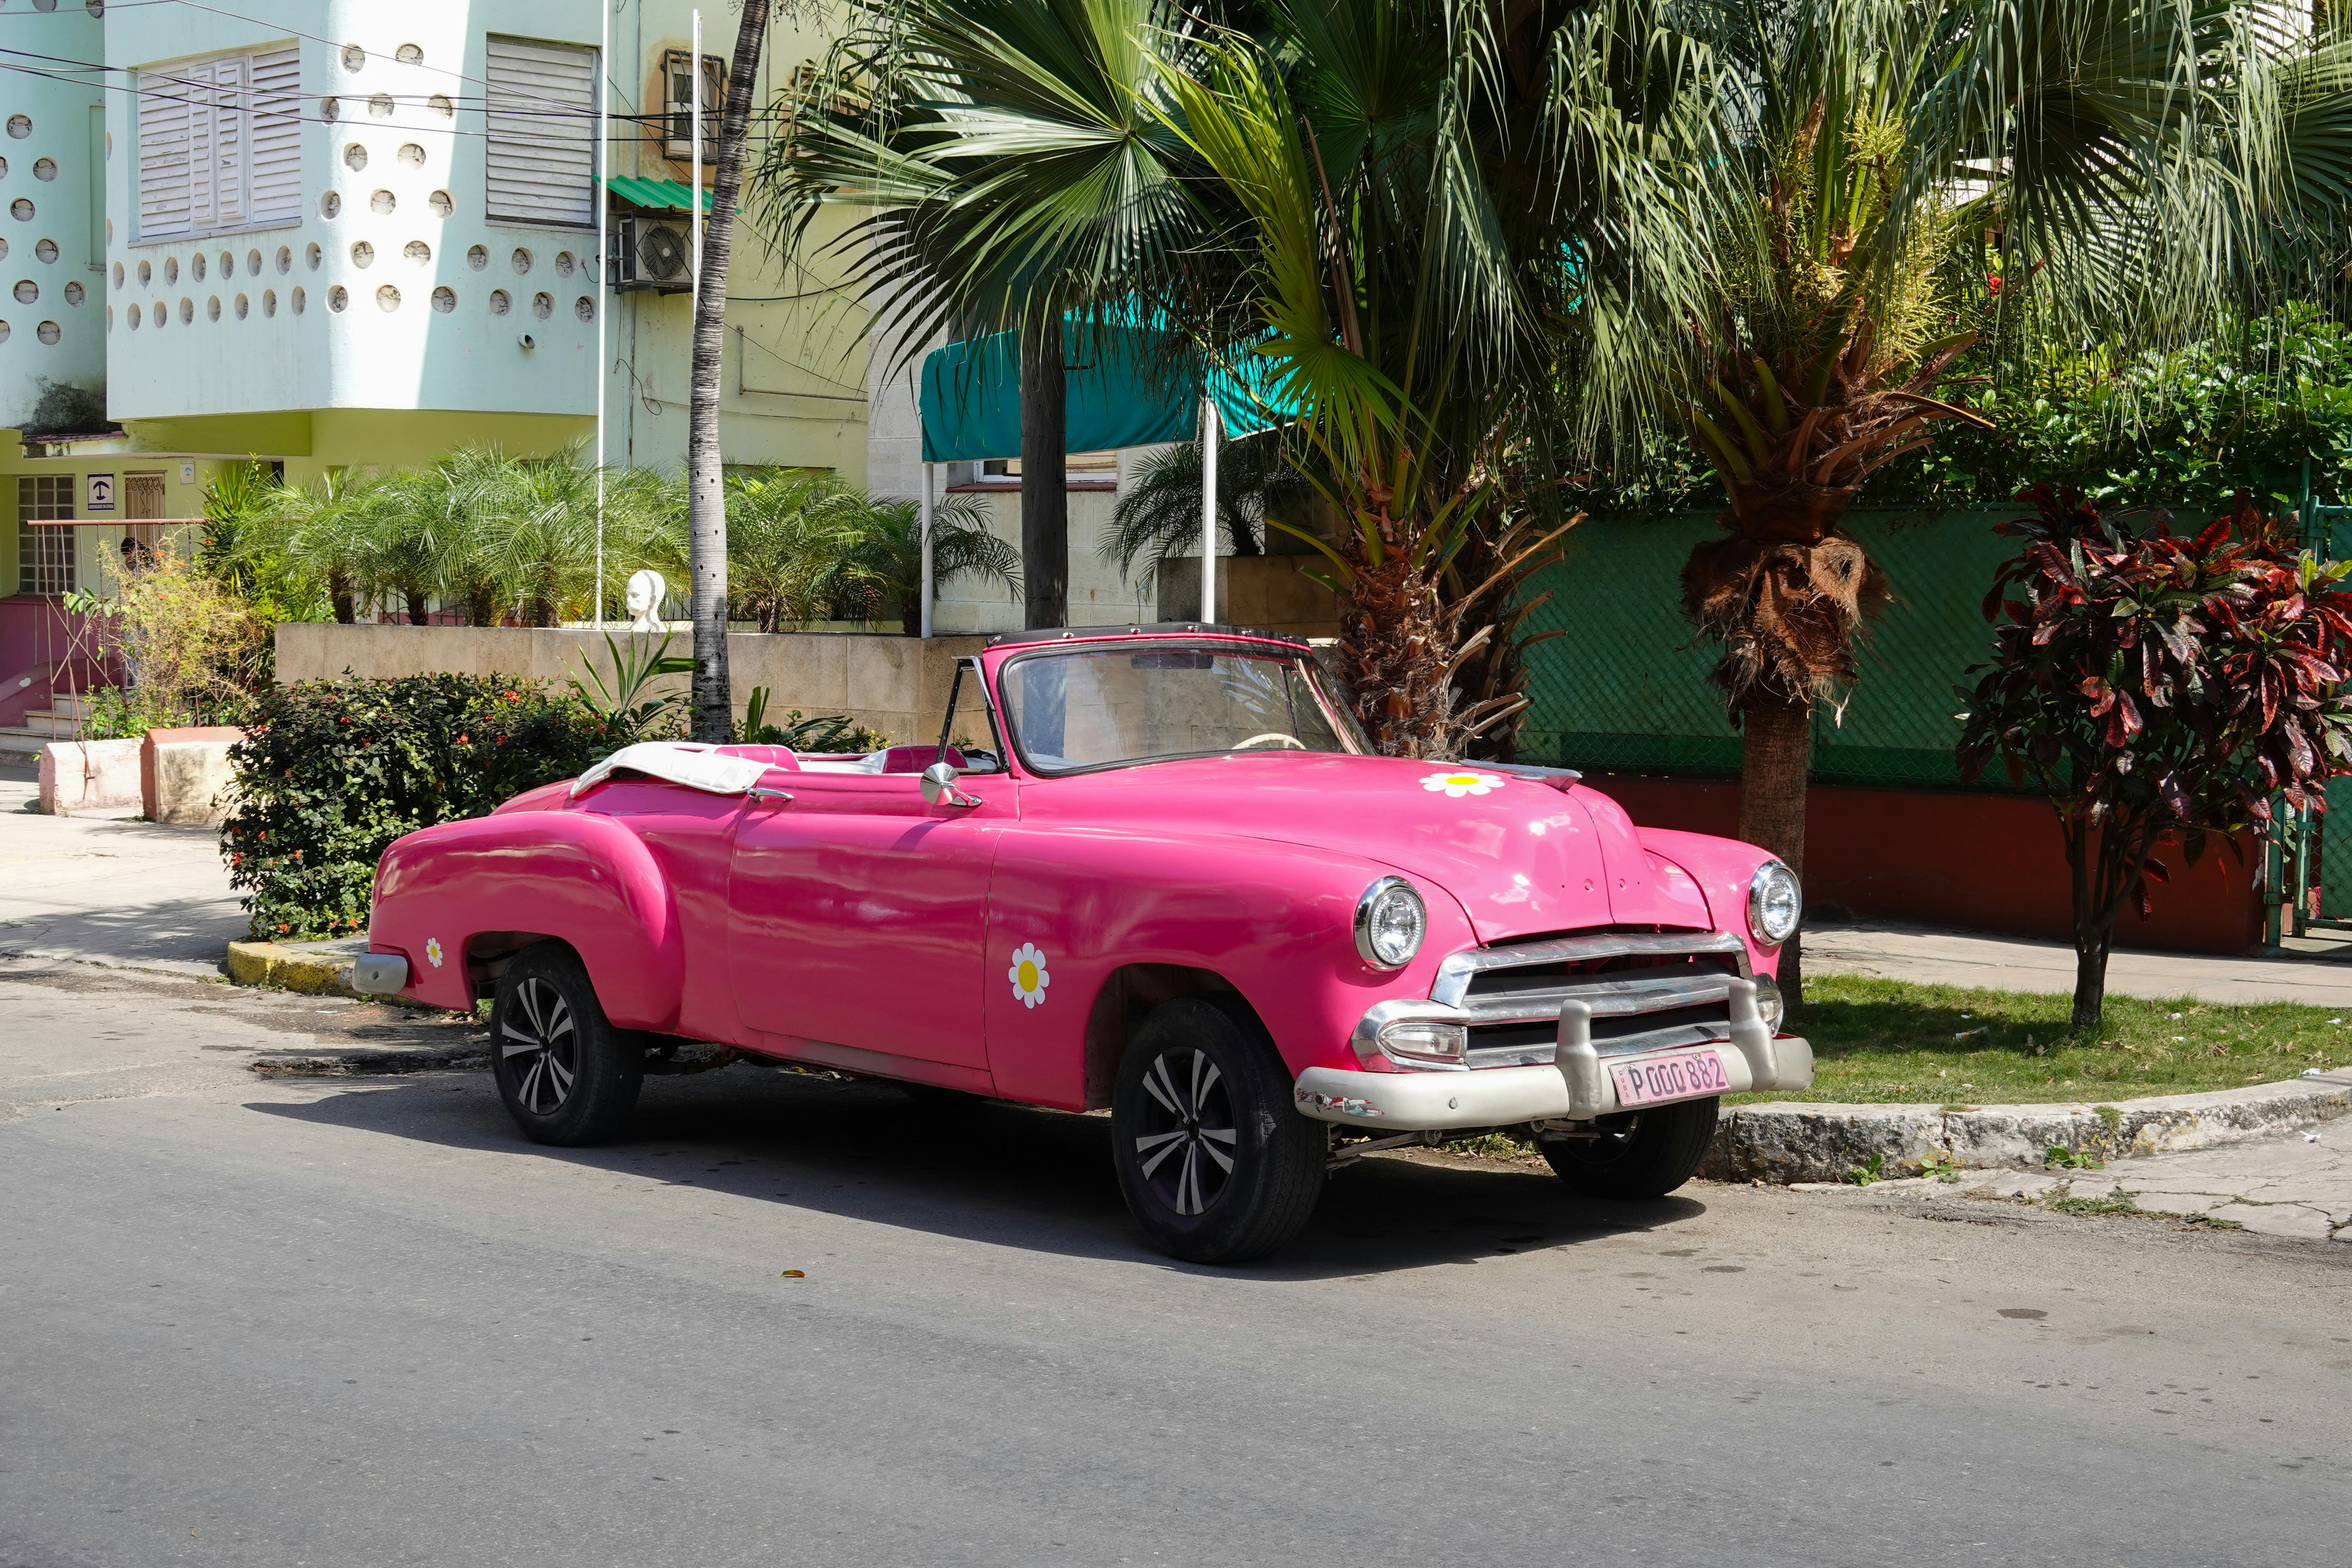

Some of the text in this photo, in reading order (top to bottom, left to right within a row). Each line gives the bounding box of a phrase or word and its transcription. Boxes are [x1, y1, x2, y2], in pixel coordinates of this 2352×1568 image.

[1618, 1070, 1630, 1098] CUBA
[1628, 1068, 1643, 1100] P
[1685, 1058, 1726, 1091] 882
